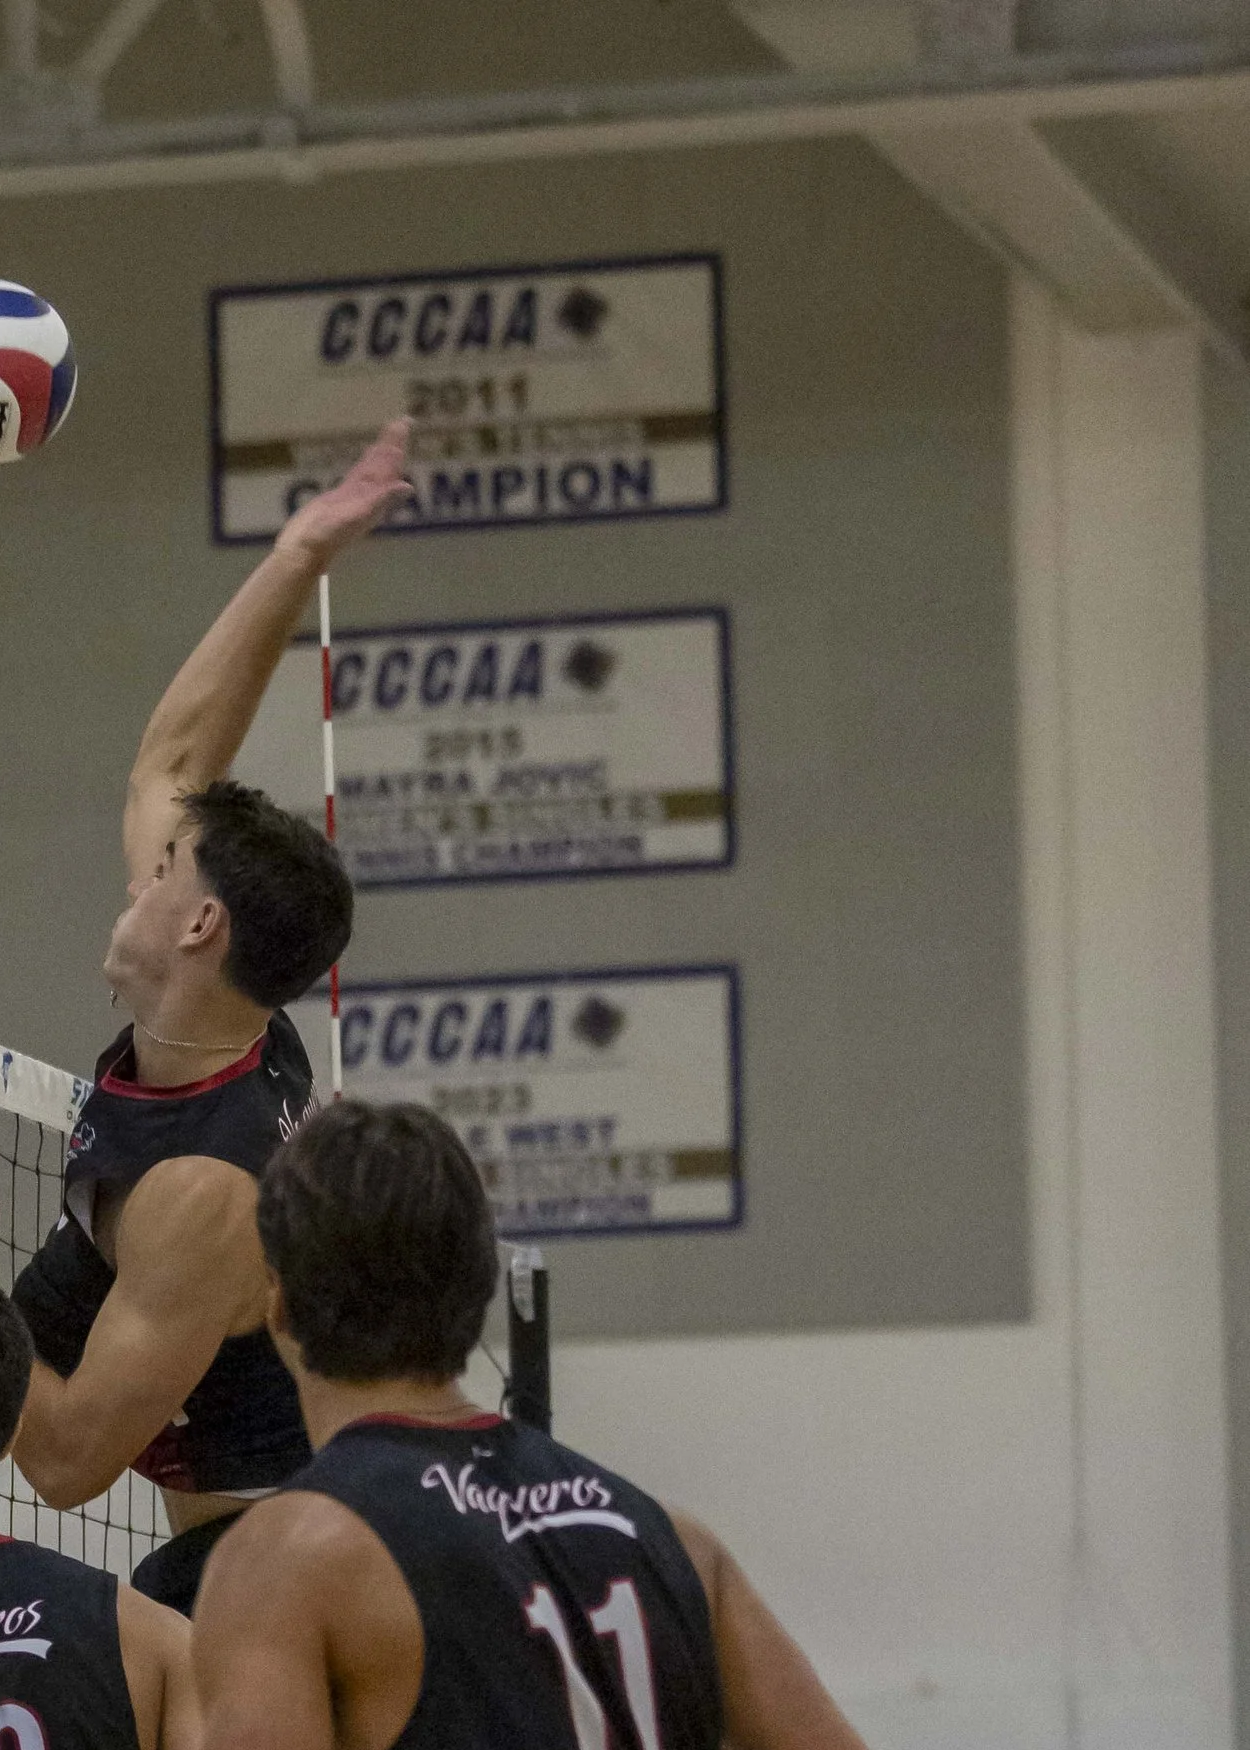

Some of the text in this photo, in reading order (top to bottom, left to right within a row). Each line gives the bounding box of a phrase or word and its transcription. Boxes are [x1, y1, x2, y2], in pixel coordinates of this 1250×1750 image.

[319, 287, 538, 364] CCCAA
[286, 458, 653, 522] CAMPION
[330, 641, 544, 714] CCCAA
[339, 996, 556, 1069] CCCAA
[421, 1463, 630, 1543] Vaqueros
